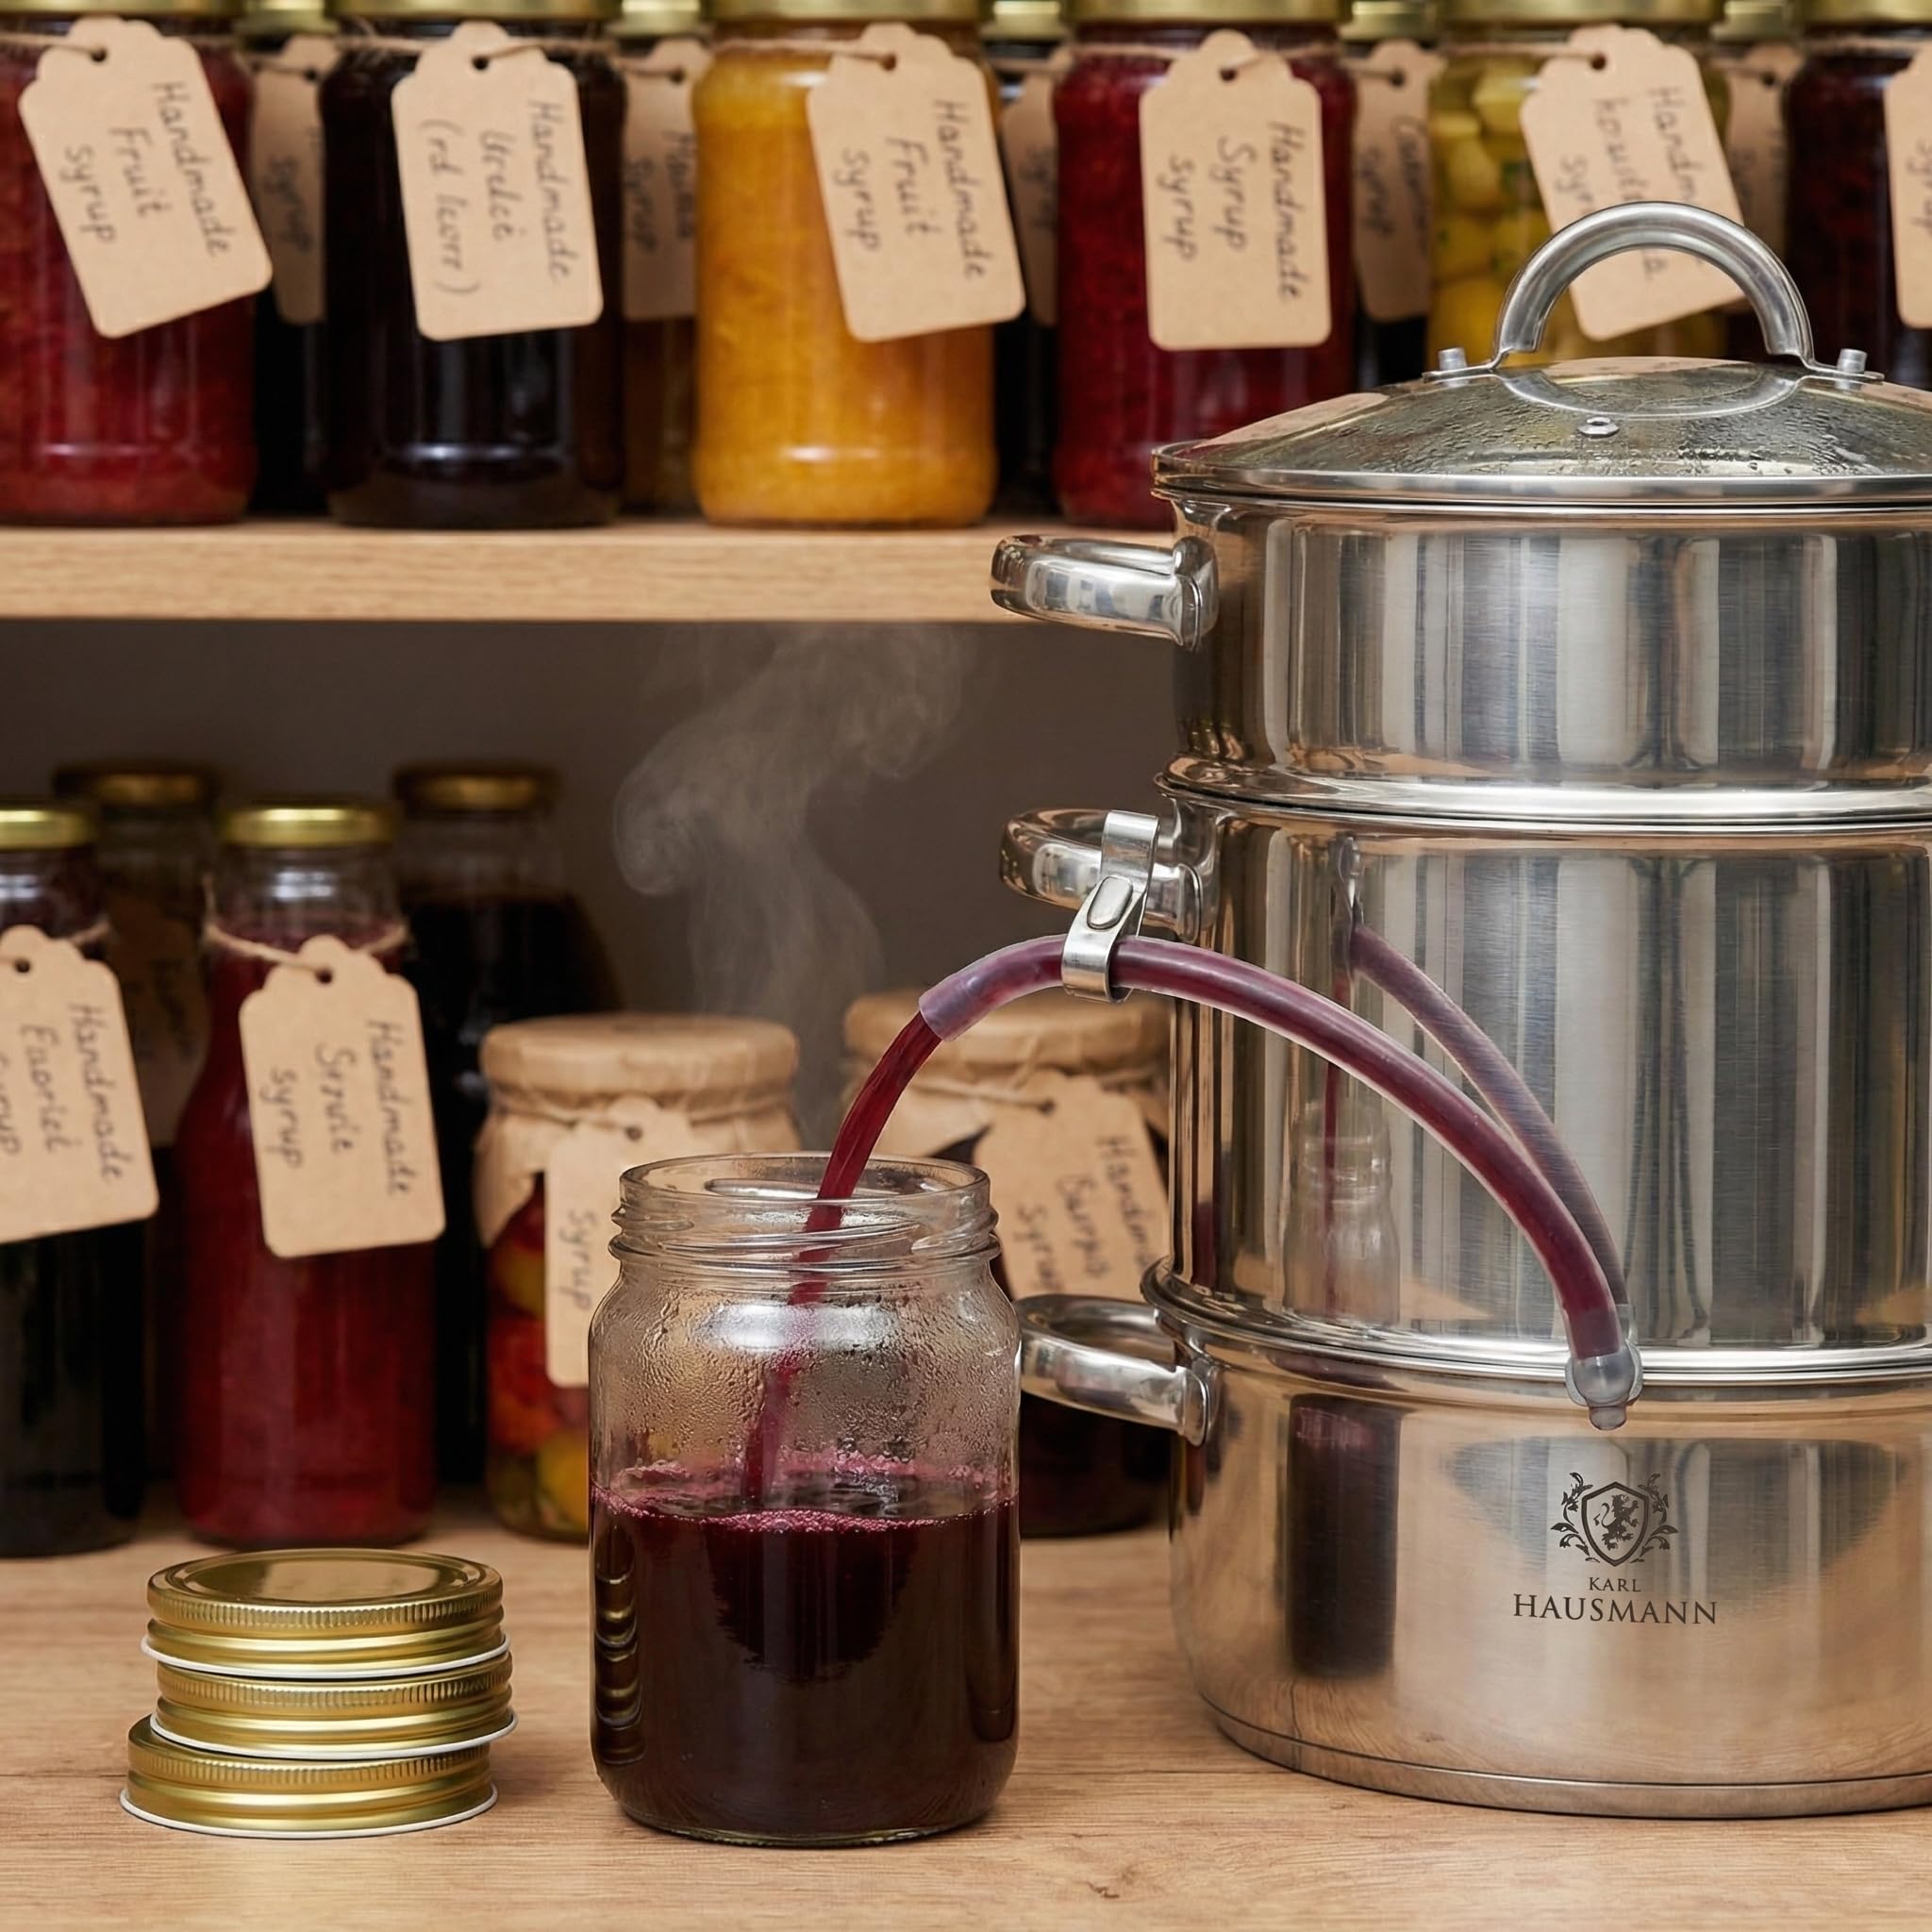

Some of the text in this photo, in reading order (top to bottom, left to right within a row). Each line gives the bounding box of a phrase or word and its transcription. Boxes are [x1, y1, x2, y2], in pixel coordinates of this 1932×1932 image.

[109, 125, 168, 220] Fruit
[152, 80, 231, 258] Handmade
[526, 96, 580, 286] Handmade
[885, 136, 942, 236] Fruit
[935, 98, 995, 281] Handmade
[1267, 120, 1310, 302] Handmade
[69, 1002, 133, 1184] Handmade
[365, 1019, 422, 1196] Handmade
[1513, 1592, 1719, 1625] HAUSMANN
[1589, 1576, 1641, 1592] KARL
